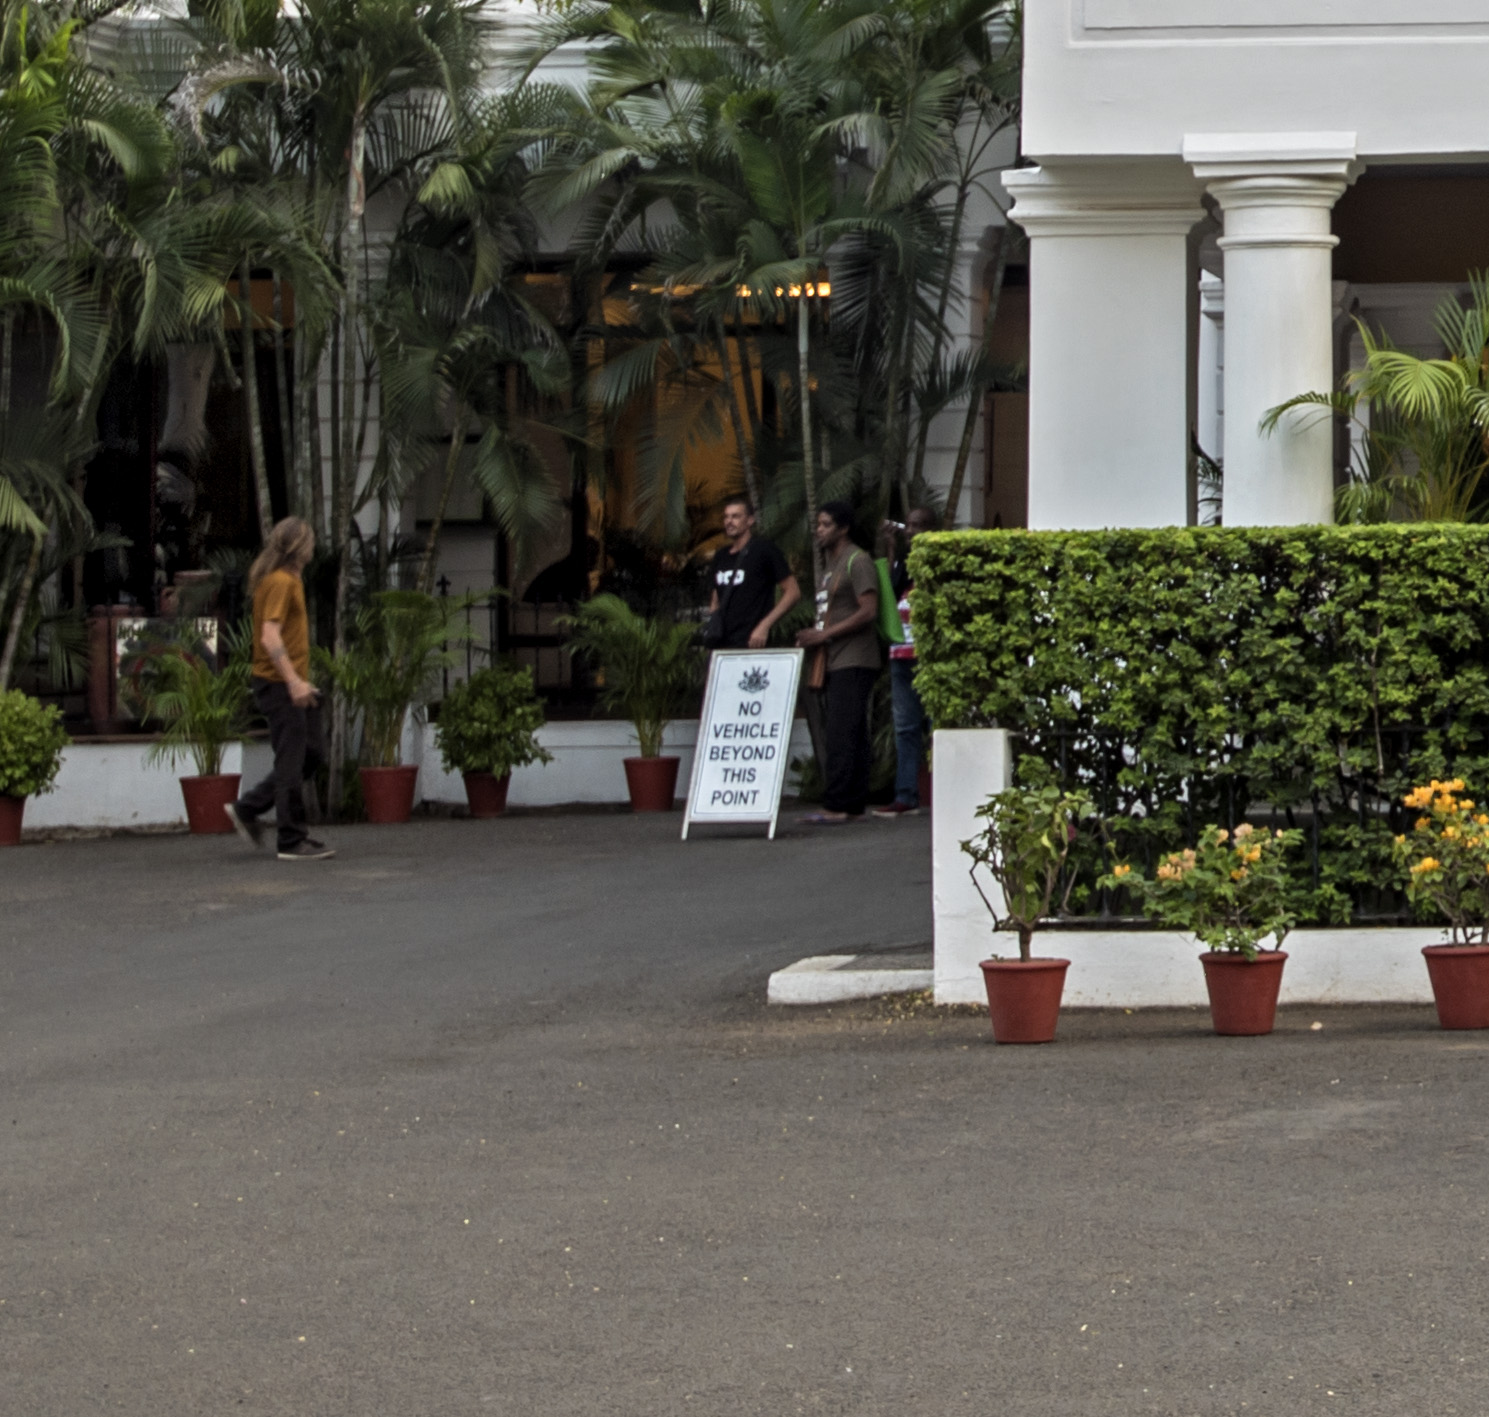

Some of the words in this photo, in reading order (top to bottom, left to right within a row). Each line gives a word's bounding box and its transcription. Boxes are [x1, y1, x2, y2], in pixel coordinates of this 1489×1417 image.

[738, 701, 762, 716] NO
[713, 722, 779, 738] VEHICLE
[709, 746, 775, 760] BEYOND
[722, 768, 756, 782] THIS
[711, 790, 759, 805] POINT
